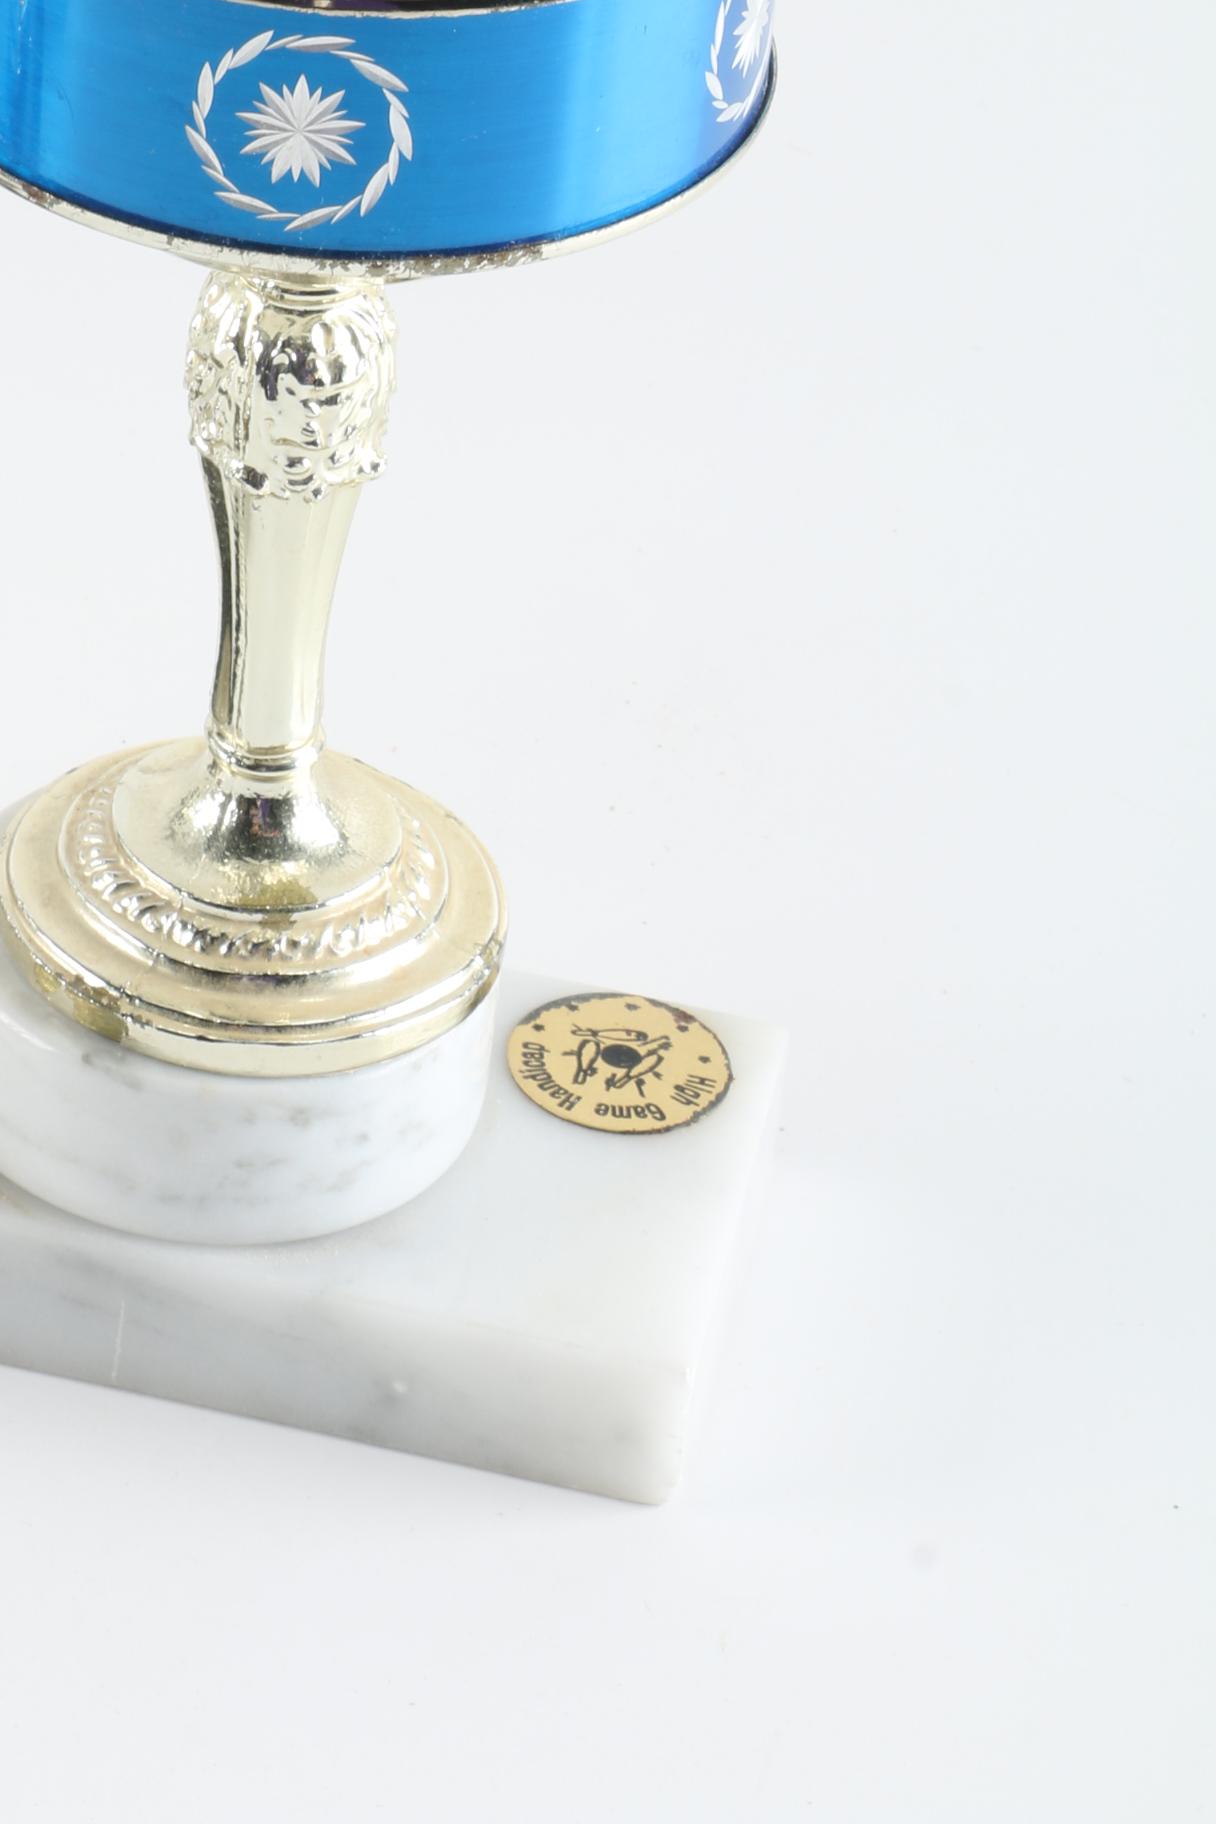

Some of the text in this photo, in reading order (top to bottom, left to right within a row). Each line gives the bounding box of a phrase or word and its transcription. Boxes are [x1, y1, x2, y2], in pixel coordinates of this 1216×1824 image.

[519, 1040, 718, 1122] High Game Handicap
